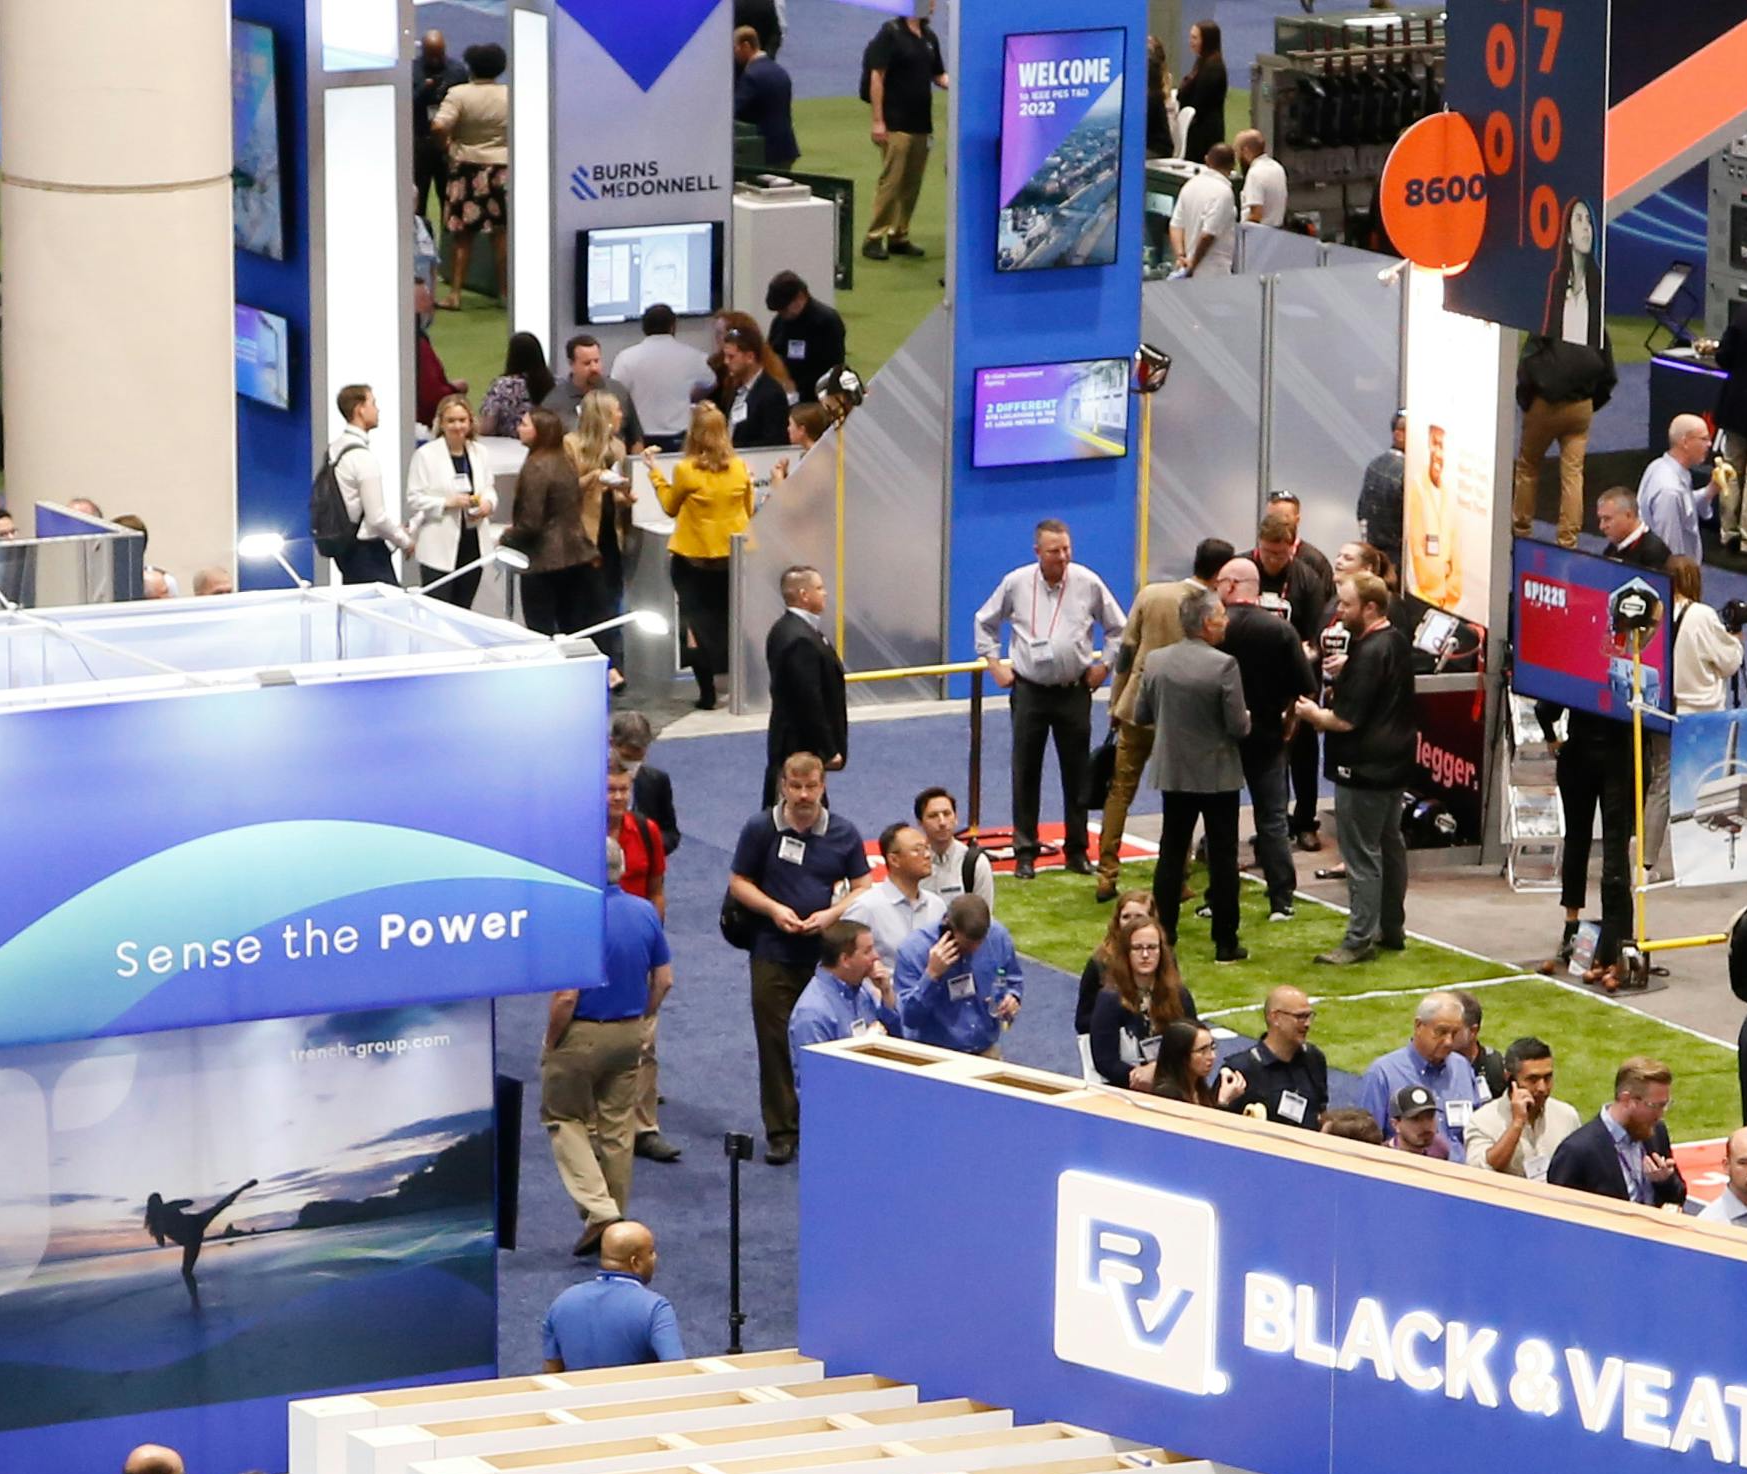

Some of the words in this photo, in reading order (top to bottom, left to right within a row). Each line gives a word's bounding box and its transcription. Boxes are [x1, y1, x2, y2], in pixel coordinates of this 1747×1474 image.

[1018, 58, 1111, 87] WELCOME
[1019, 101, 1056, 116] 2022
[593, 161, 658, 181] BURNS
[1405, 173, 1488, 206] 8600
[996, 400, 1058, 413] DIFFERENT
[116, 930, 260, 980] Sense
[282, 917, 359, 959] the
[378, 905, 528, 950] Power
[1242, 1269, 1498, 1410] BLACK
